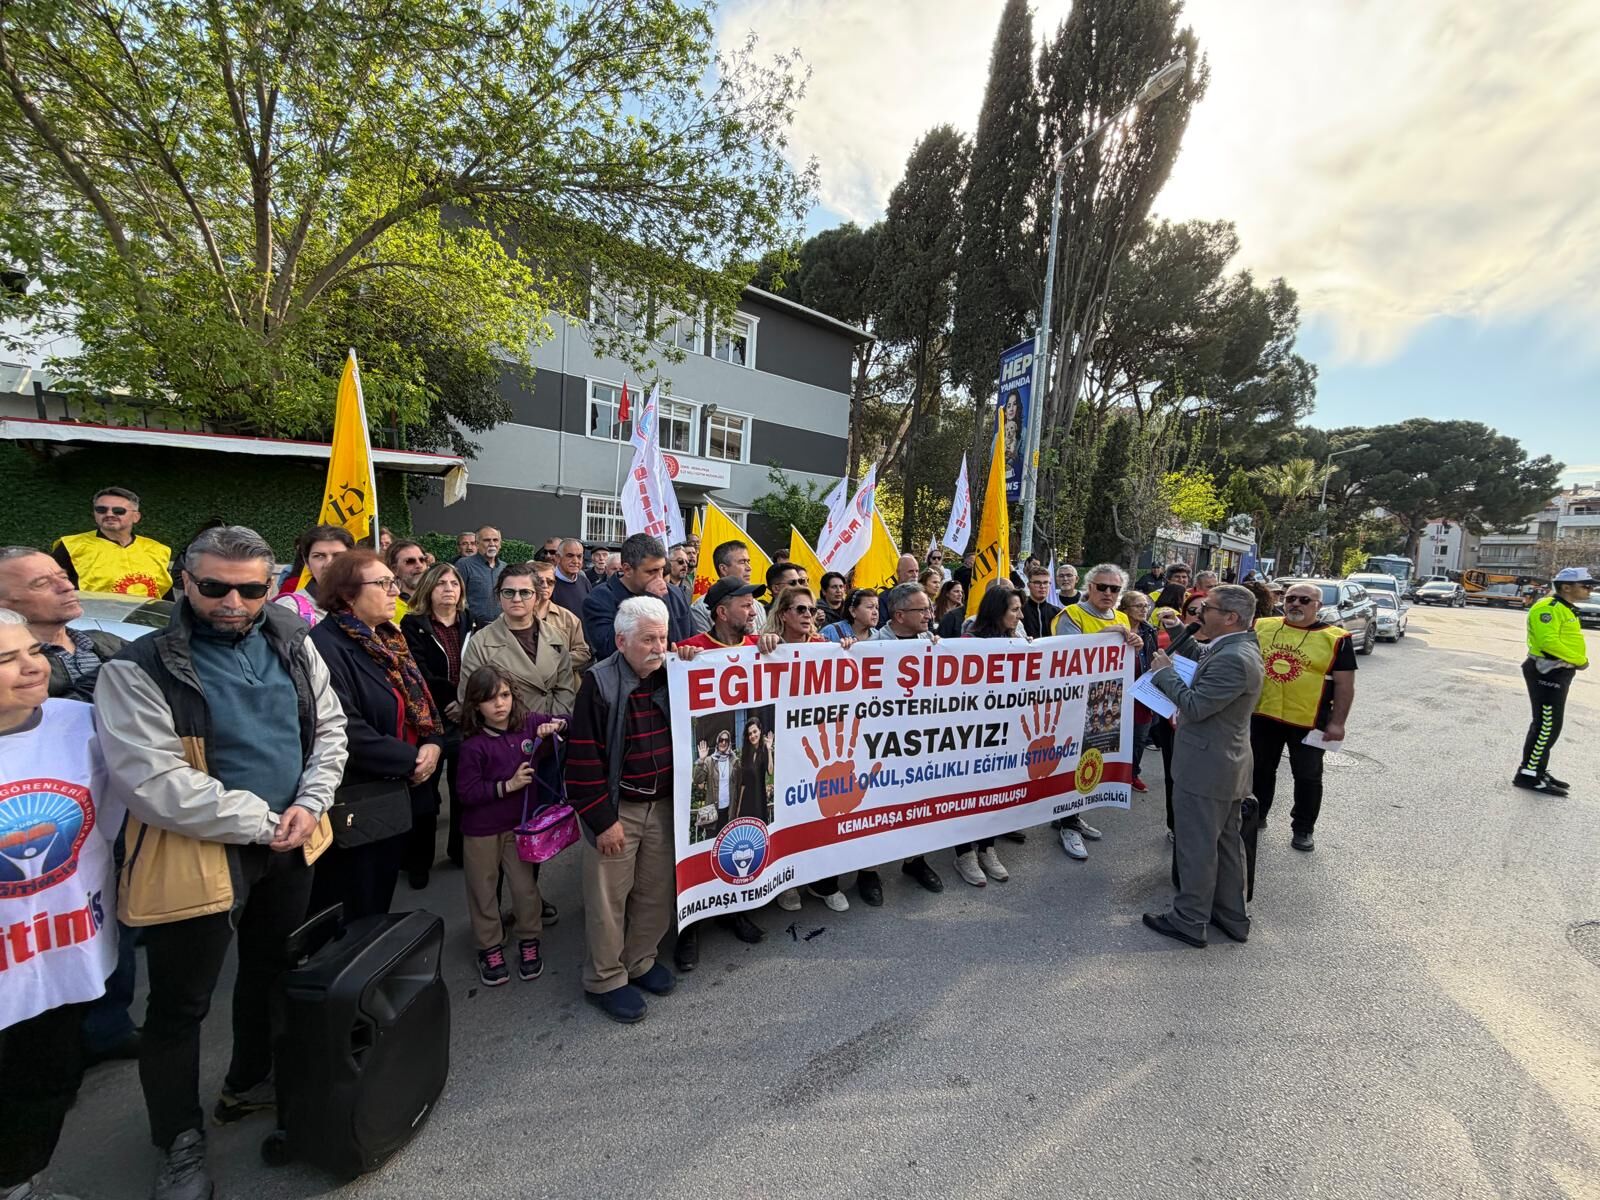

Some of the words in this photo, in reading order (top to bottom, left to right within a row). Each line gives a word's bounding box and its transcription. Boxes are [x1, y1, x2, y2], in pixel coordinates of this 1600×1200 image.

[1000, 376, 1030, 393] YANINDA
[1001, 353, 1033, 382] HEP
[688, 651, 884, 711] EĞİTİMDE
[897, 646, 1043, 698] ŞİDDETE
[1049, 645, 1126, 678] HAYIR!
[787, 704, 849, 729] HEDEF
[855, 692, 979, 719] GÖSTERİLDİK
[984, 683, 1084, 710] ÖLDÜRÜLDÜK!
[863, 722, 1009, 760] YASTAYIZ!
[785, 772, 853, 806] GÜVENLİ
[973, 752, 1017, 774] EĞİTİM
[1020, 742, 1079, 768] İSTİYORUZ!
[837, 811, 903, 835] KEMALPAŞA
[906, 803, 932, 821] SİVİL
[935, 797, 976, 815] TOPLUM
[978, 788, 1027, 808] KURULUŞU
[1053, 798, 1083, 815] KEMALPAŞA
[1085, 789, 1127, 805] TEMSİLCİLİĞİ
[741, 865, 795, 902] TEMSİLCİLİĞİ
